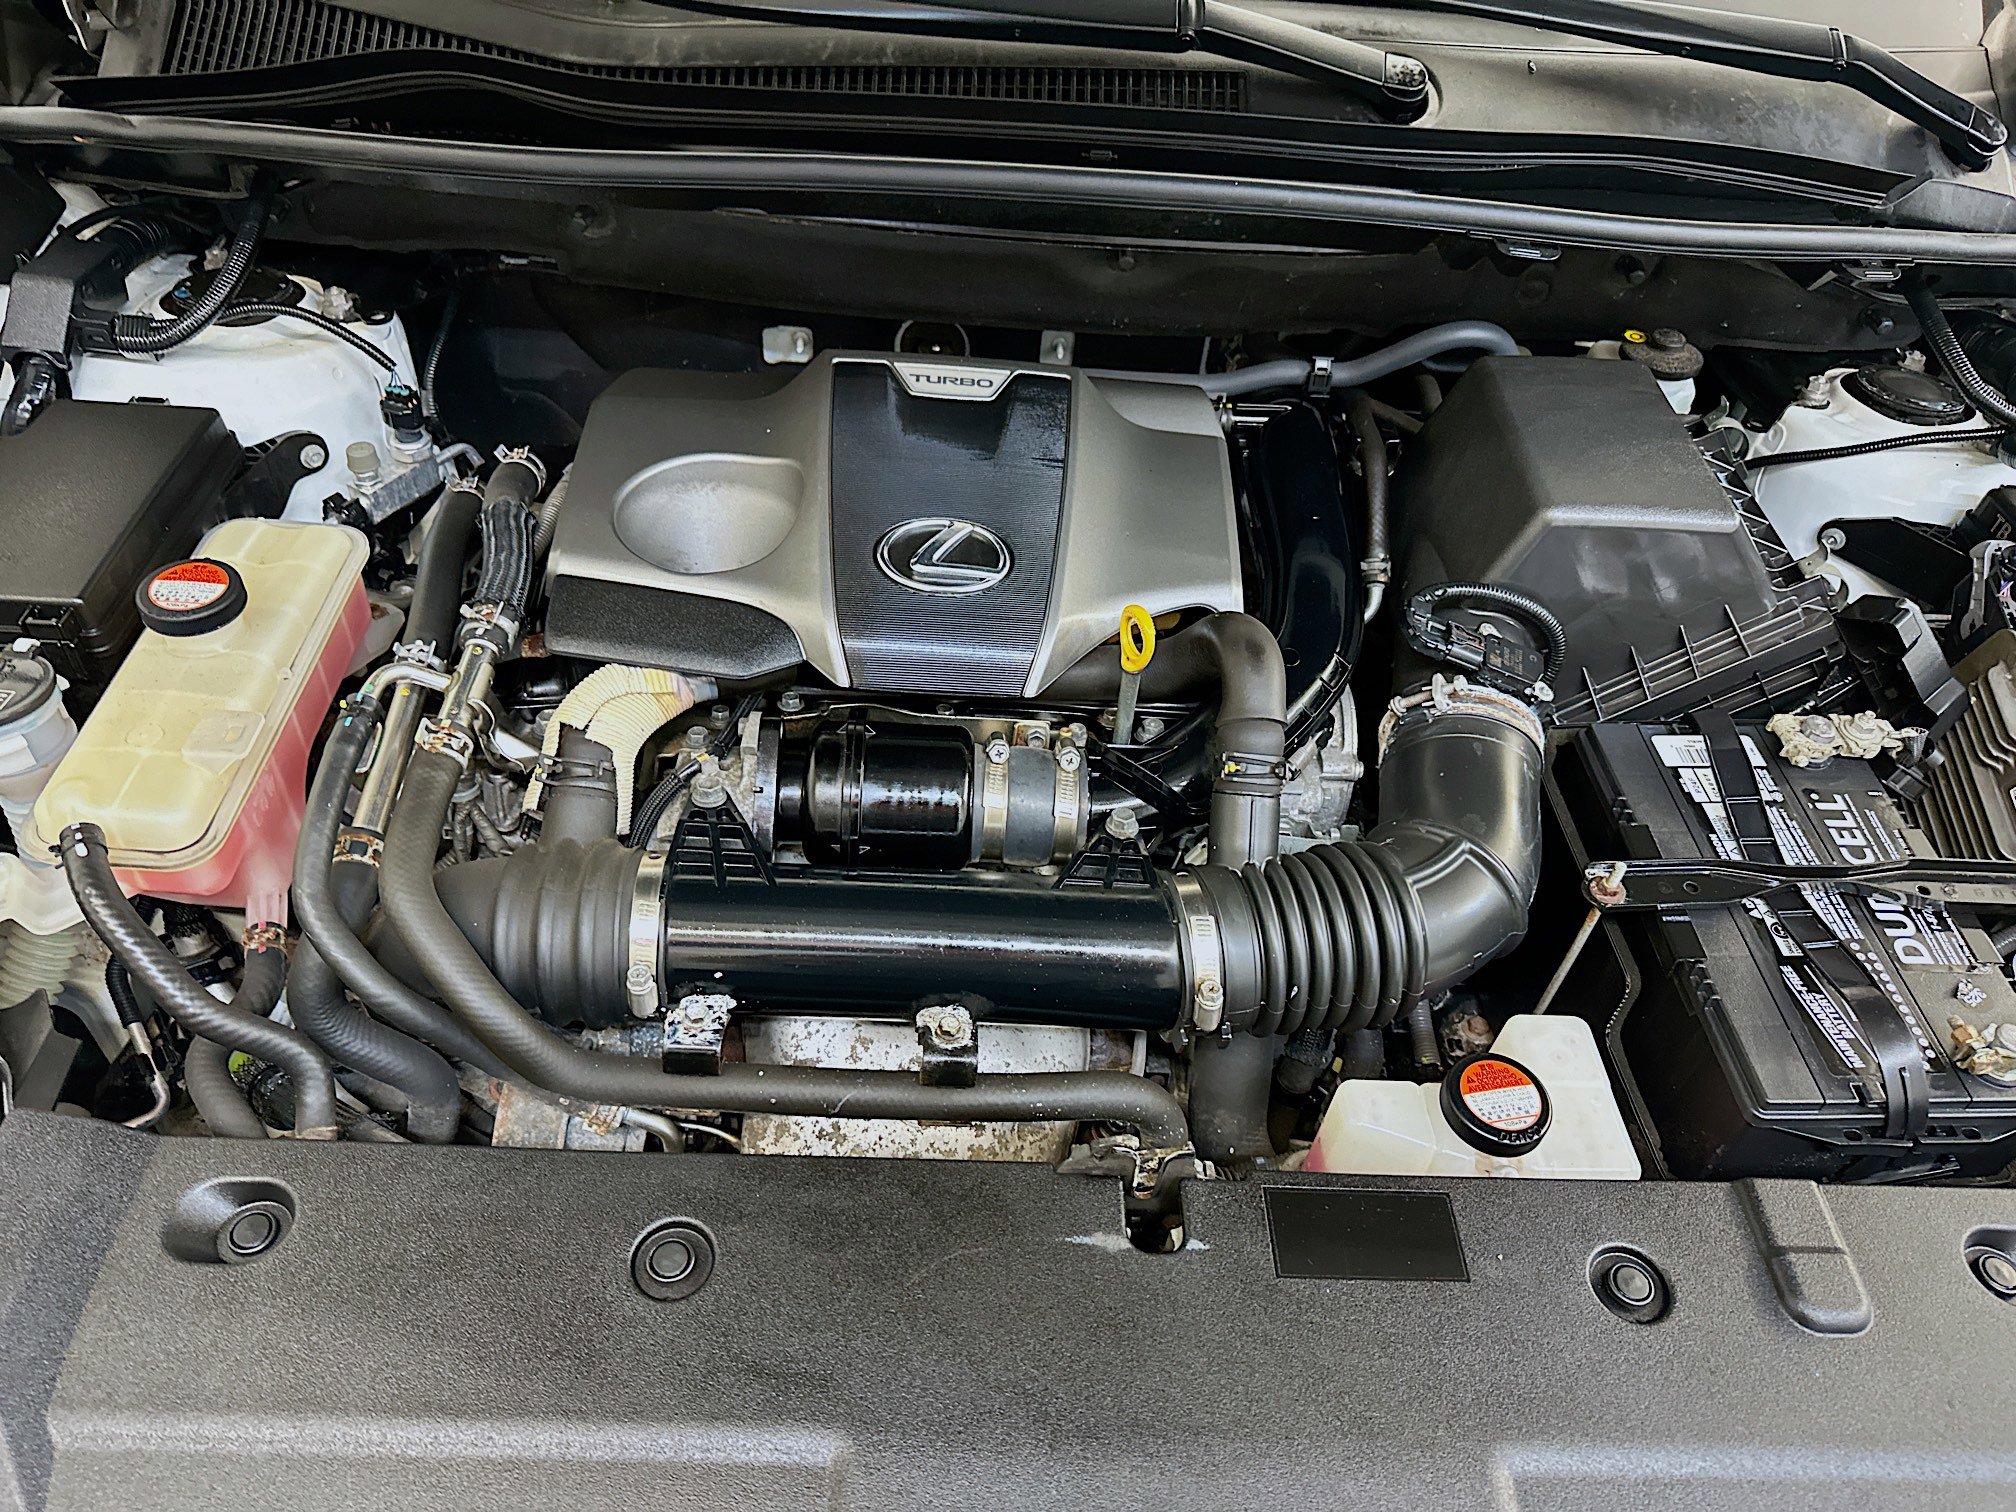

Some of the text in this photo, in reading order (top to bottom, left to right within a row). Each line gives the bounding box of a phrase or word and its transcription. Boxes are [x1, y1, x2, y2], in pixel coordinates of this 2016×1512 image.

[909, 373, 994, 388] TURBO
[1990, 513, 2012, 540] TB
[1779, 964, 1867, 1069] MAINTENANCE-FREE
[1811, 991, 1856, 1039] BATTERY
[1473, 1067, 1509, 1078] WARNING
[1468, 1078, 1525, 1093] AVERTISSEMENT
